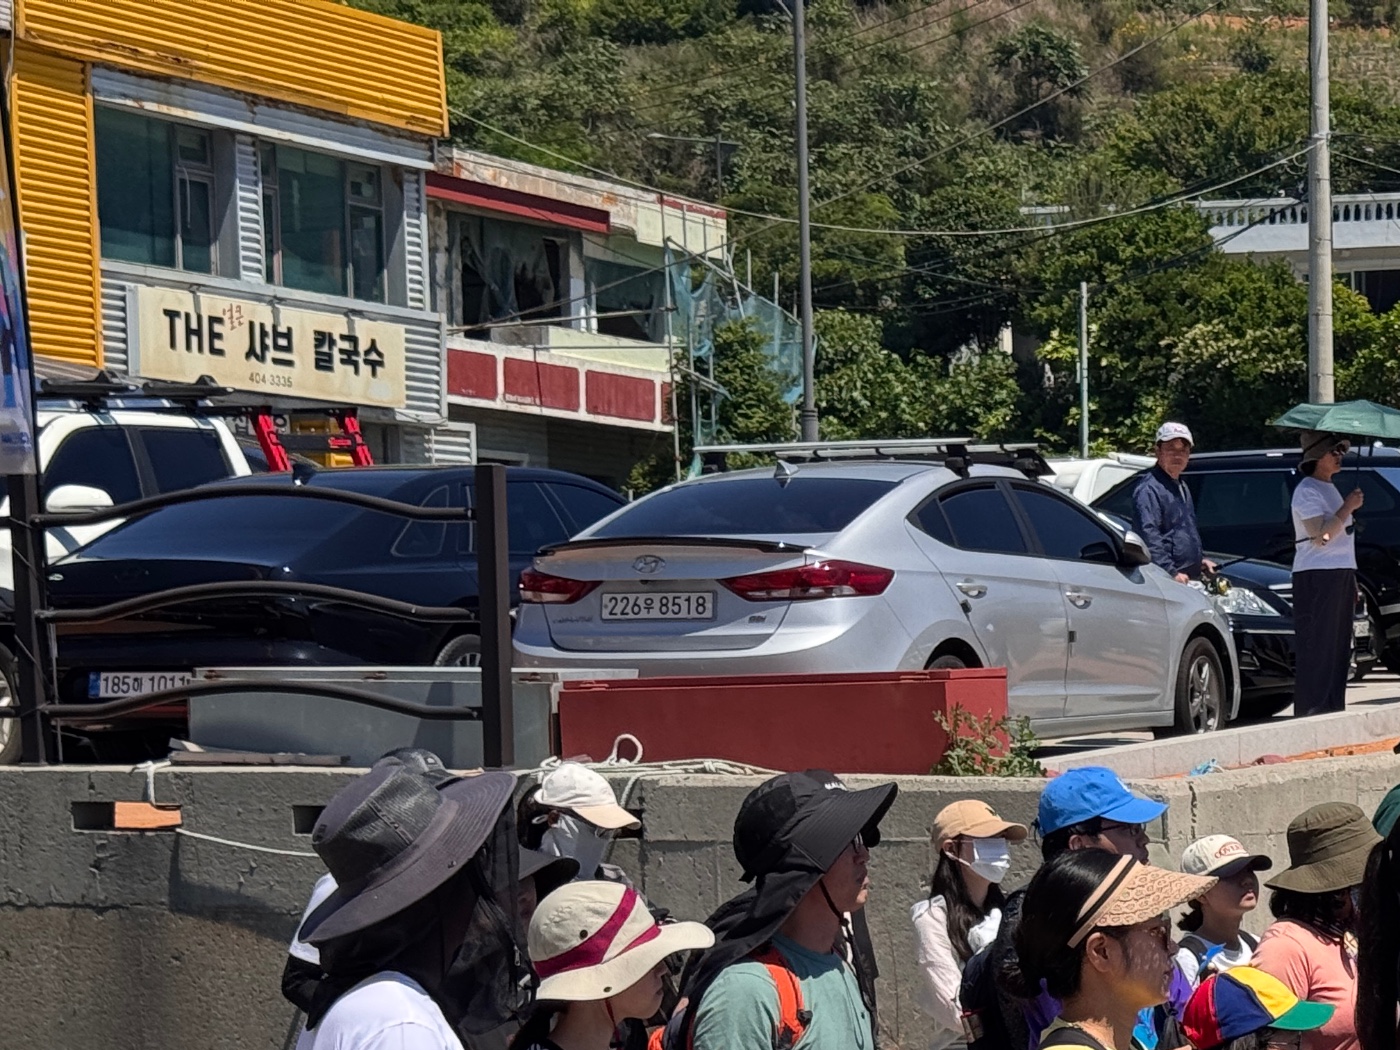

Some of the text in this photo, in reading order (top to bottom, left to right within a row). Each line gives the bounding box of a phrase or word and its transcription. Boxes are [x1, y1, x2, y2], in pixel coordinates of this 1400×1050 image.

[163, 308, 386, 379] THE 샤브 칼국수
[608, 595, 707, 616] 226우 8518
